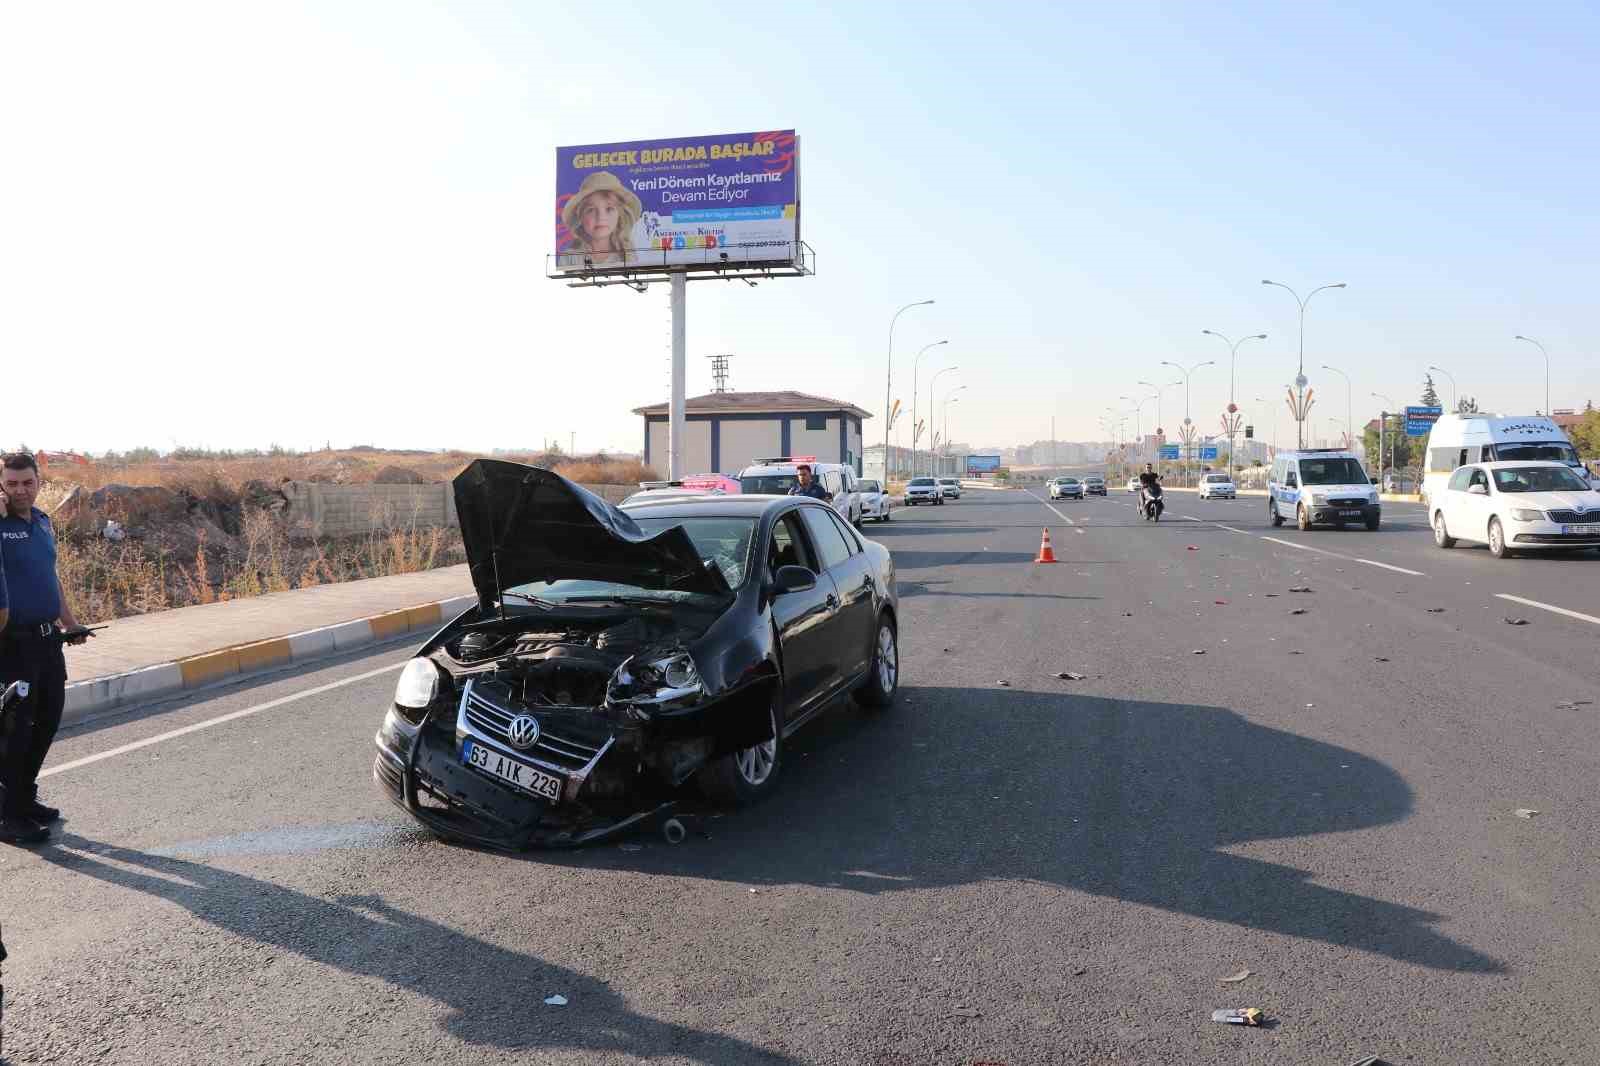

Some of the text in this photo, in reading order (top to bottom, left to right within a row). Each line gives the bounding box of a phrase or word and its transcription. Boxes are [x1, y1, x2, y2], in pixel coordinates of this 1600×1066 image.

[573, 151, 636, 168] GELECEK
[640, 145, 707, 164] BURADA
[710, 141, 775, 161] BAŞLAR
[630, 178, 657, 190] Yeni
[658, 176, 706, 188] Dönem
[662, 188, 750, 203] Devam Ediyor
[471, 745, 559, 798] 63 AIK 229
